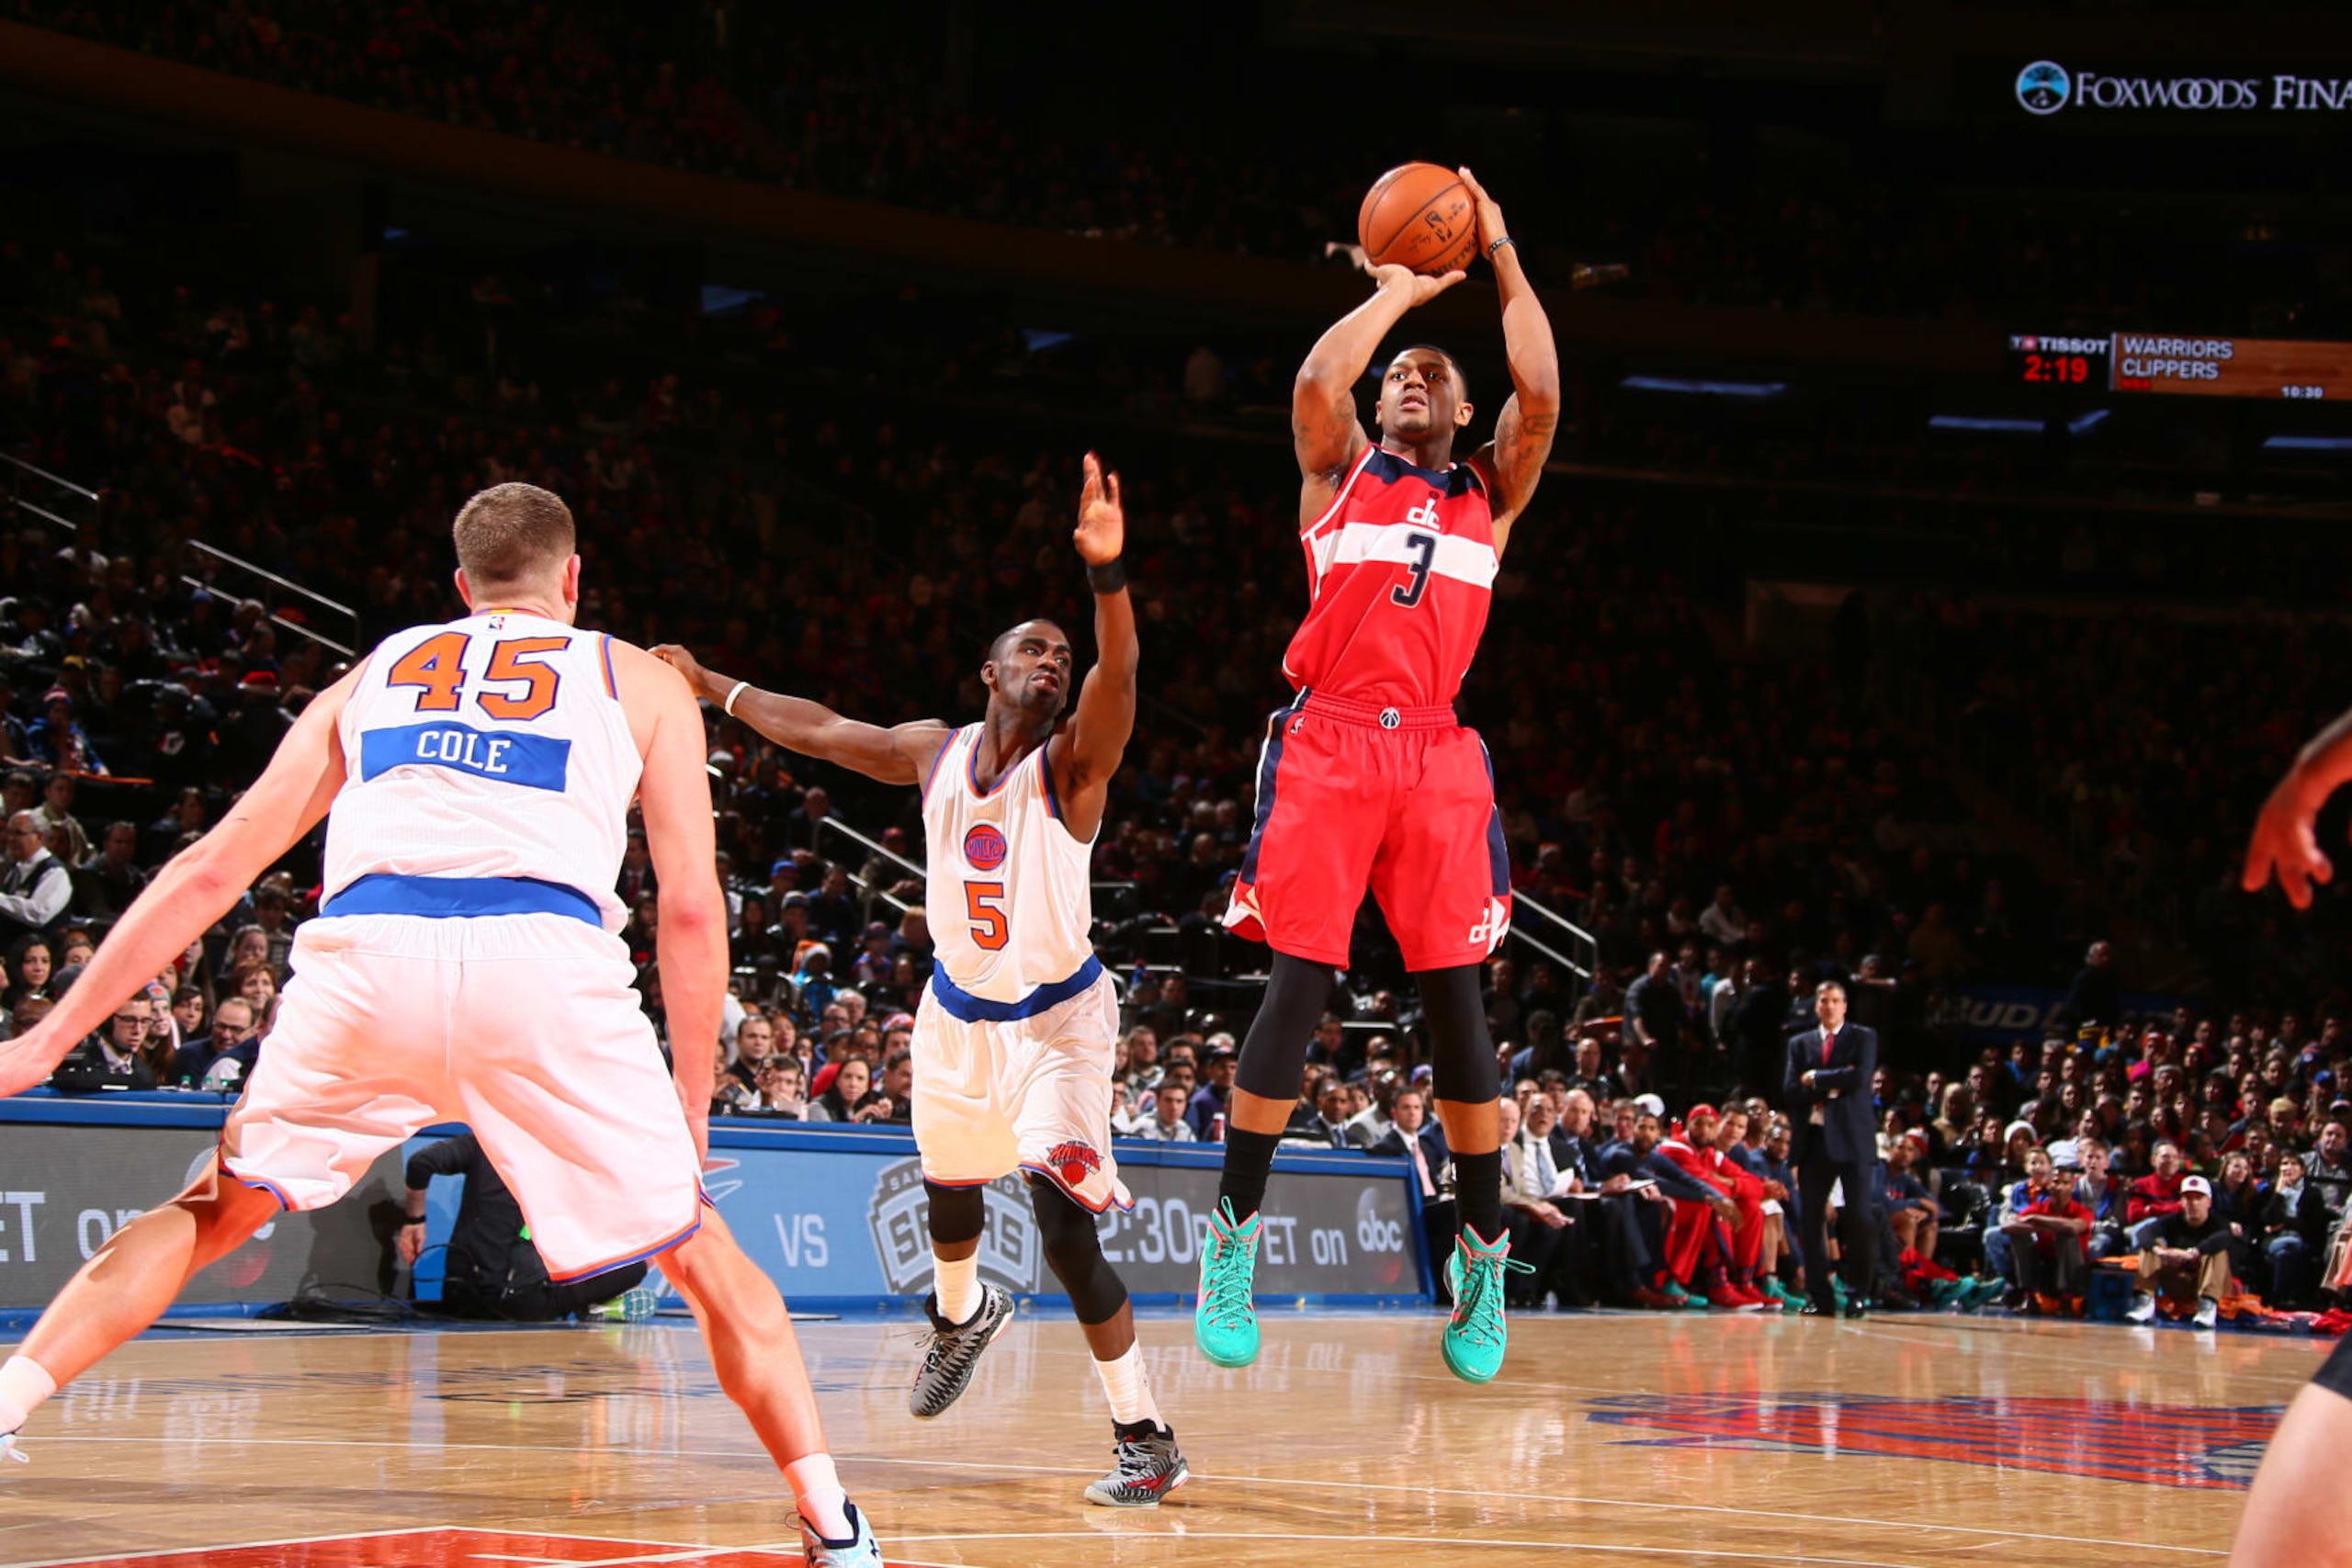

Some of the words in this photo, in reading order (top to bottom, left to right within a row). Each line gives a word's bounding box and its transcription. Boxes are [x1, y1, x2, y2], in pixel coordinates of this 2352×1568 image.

[2075, 73, 2256, 107] FOXWOODS
[2039, 337, 2109, 354] TISSOT
[2122, 337, 2233, 359] WARRIORS
[2024, 355, 2087, 382] 2:19
[2122, 358, 2219, 379] CLIPPERS
[1390, 532, 1437, 609] 3
[387, 631, 571, 721] 45
[416, 730, 511, 773] COLE
[963, 880, 1009, 951] 5
[774, 1213, 829, 1268] VS
[1262, 1216, 1296, 1265] ET
[1311, 1228, 1348, 1266] on
[1358, 1209, 1403, 1253] abc
